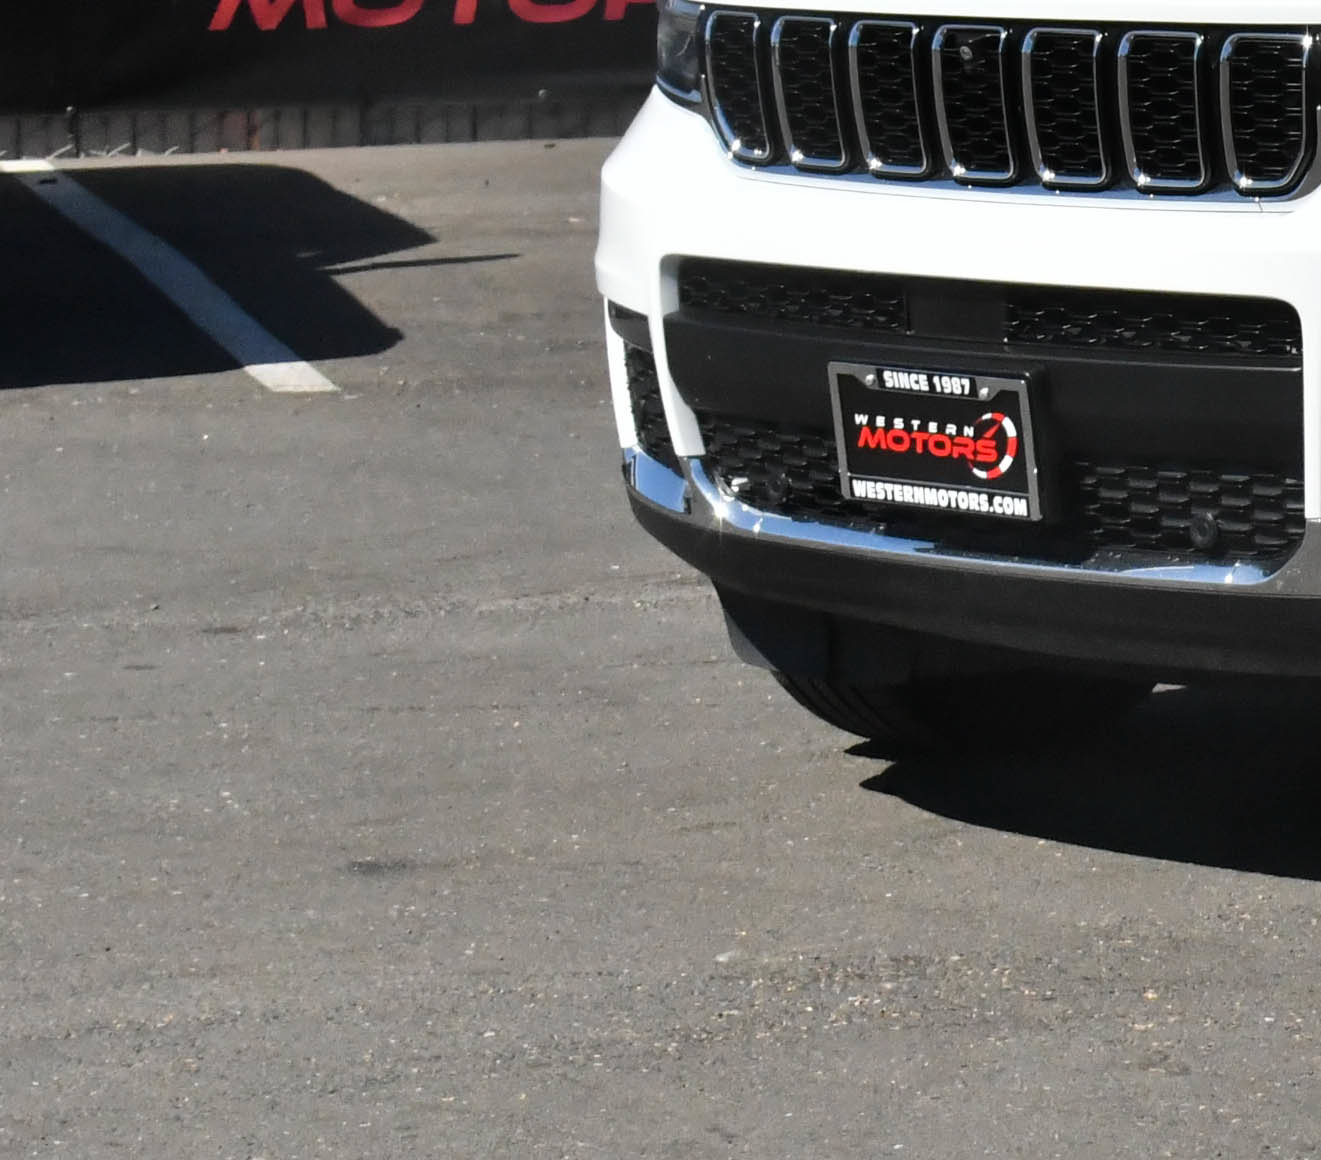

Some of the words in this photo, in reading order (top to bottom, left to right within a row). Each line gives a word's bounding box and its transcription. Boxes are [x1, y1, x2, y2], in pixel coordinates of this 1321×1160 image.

[883, 371, 929, 391] SINCE
[933, 376, 970, 395] 1987
[855, 413, 975, 438] WESTERN
[858, 427, 998, 463] MOTORS
[852, 480, 1028, 516] WESTERNMOTORS.COM
